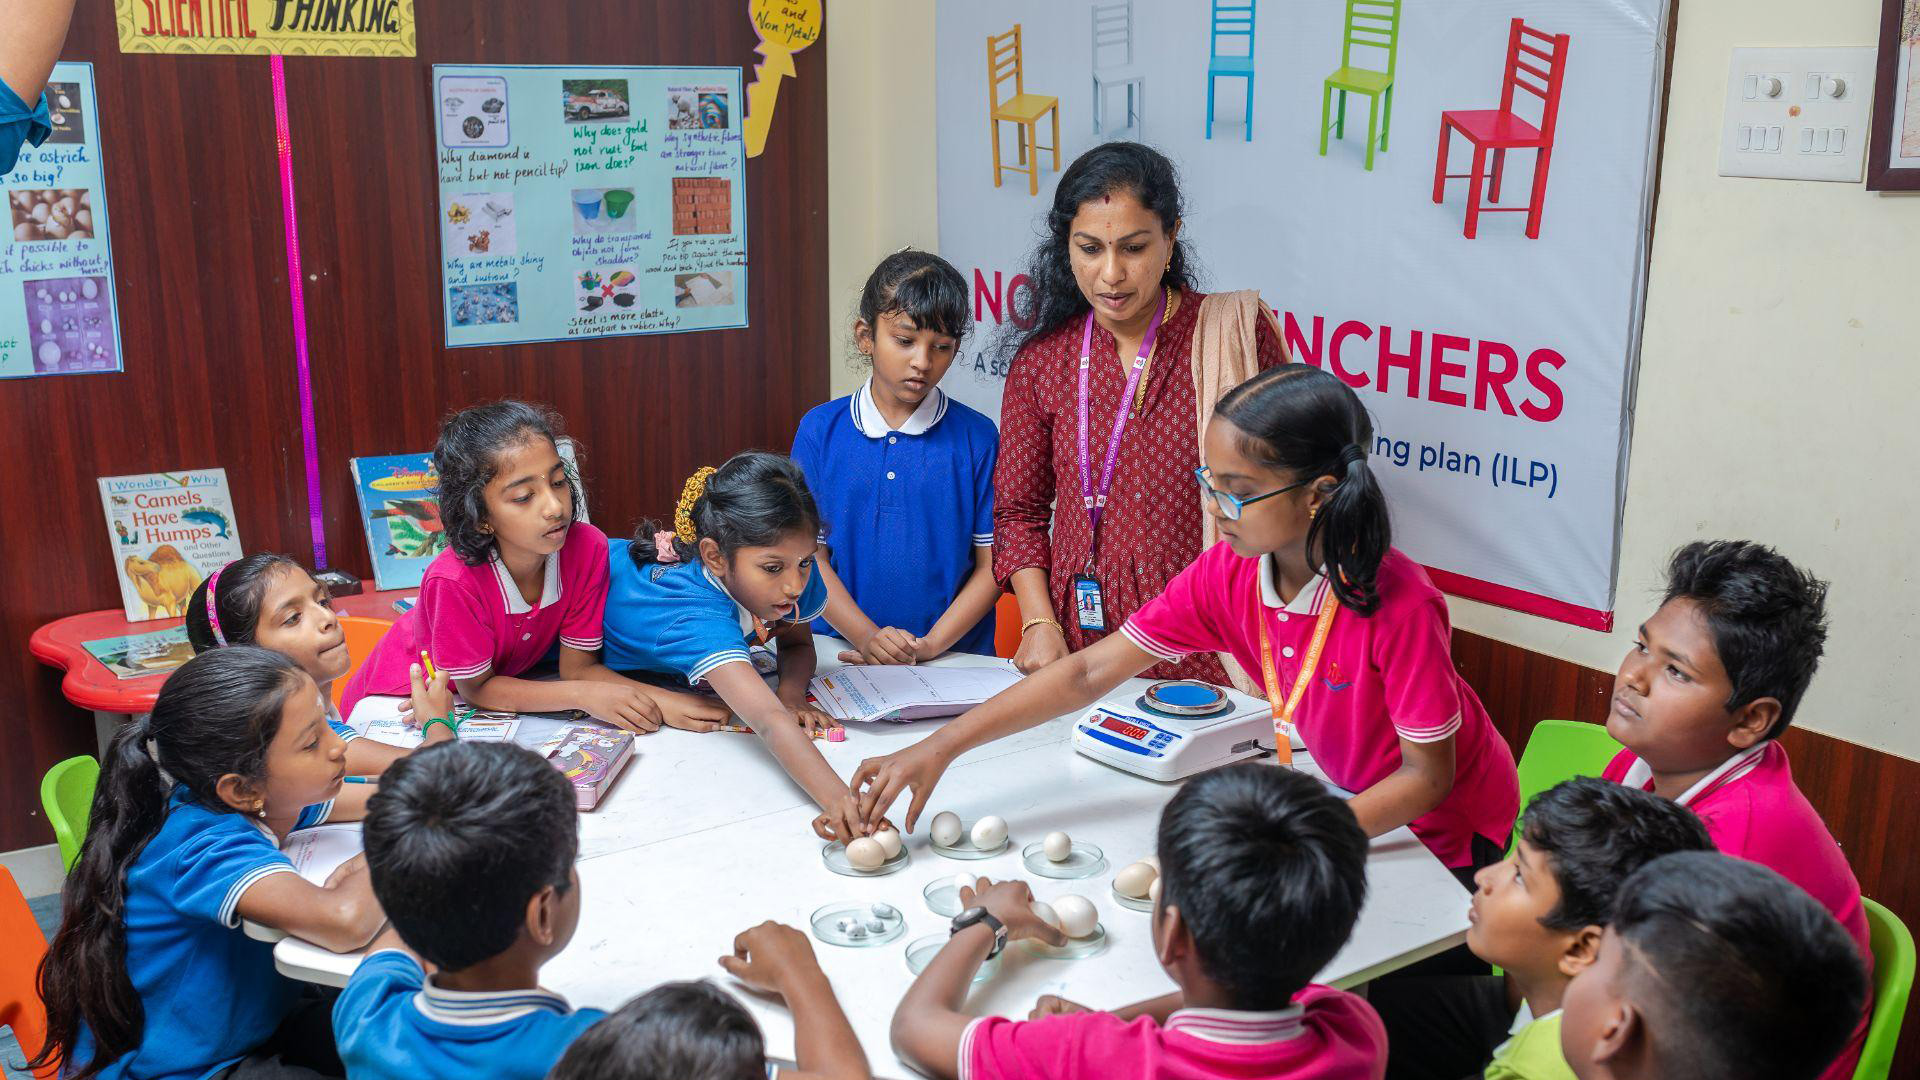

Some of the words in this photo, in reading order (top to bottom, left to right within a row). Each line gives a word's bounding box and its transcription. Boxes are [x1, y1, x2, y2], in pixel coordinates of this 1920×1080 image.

[781, 7, 807, 22] and
[573, 125, 597, 145] Why
[623, 118, 648, 145] gold
[40, 146, 90, 163] ostrich
[574, 146, 593, 156] not
[600, 143, 622, 155] rust
[631, 139, 648, 152] but
[441, 147, 462, 172] Why
[468, 146, 520, 161] diamond
[13, 173, 28, 183] so
[440, 167, 462, 184] hard
[468, 168, 489, 182] but
[493, 169, 512, 180] not
[513, 161, 547, 186] pencil
[572, 236, 592, 249] Why
[594, 235, 605, 244] do
[5, 244, 13, 256] it
[22, 242, 68, 260] possible
[77, 242, 88, 252] to
[20, 259, 53, 272] chicks
[59, 254, 101, 268] without
[447, 258, 464, 275] Why
[470, 261, 482, 269] are
[486, 256, 515, 269] metals
[448, 275, 468, 284] and
[568, 316, 597, 327] Steel
[610, 313, 637, 321] more
[568, 327, 579, 335] as
[974, 268, 1038, 332] NO
[1272, 309, 1567, 423] NCHERS
[974, 352, 986, 373] A
[1419, 442, 1481, 477] plan
[1492, 452, 1558, 499] (ILP)
[108, 481, 112, 492] I
[115, 478, 167, 490] Wonder
[191, 474, 219, 487] Why
[134, 491, 203, 509] Camels
[132, 512, 179, 527] Have
[145, 527, 212, 544] Humps
[200, 541, 221, 550] Other
[192, 551, 231, 560] Questions
[1309, 605, 1332, 656] INTERNATIONAL
